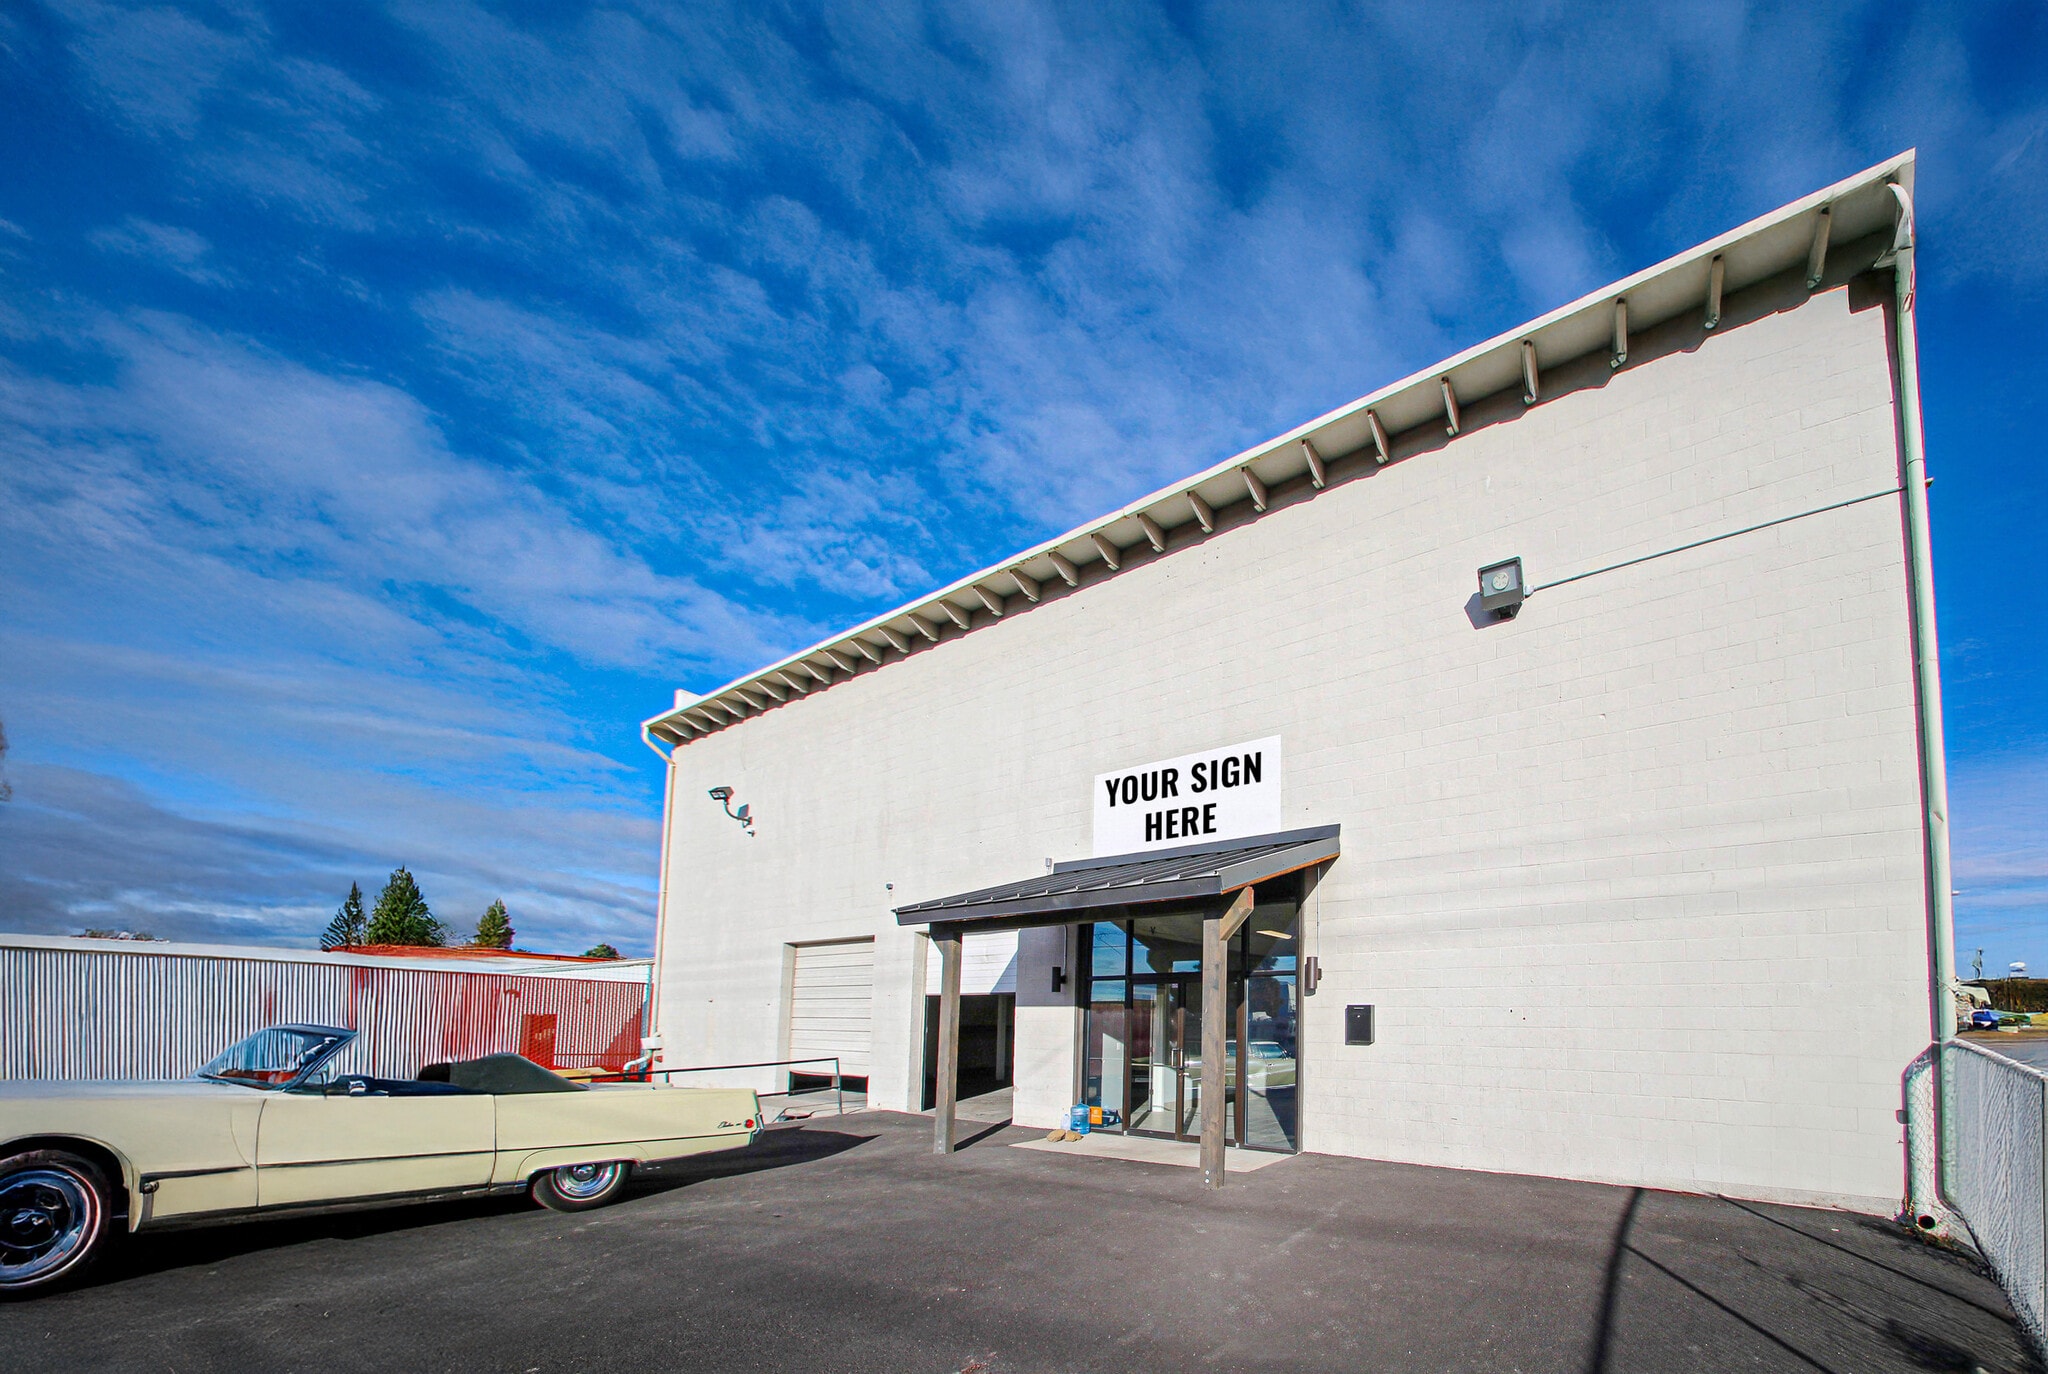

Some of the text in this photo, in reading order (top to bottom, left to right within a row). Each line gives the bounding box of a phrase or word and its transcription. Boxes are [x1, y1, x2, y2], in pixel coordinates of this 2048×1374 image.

[1105, 751, 1262, 808] YOUR SIGN
[1145, 802, 1217, 842] HERE
